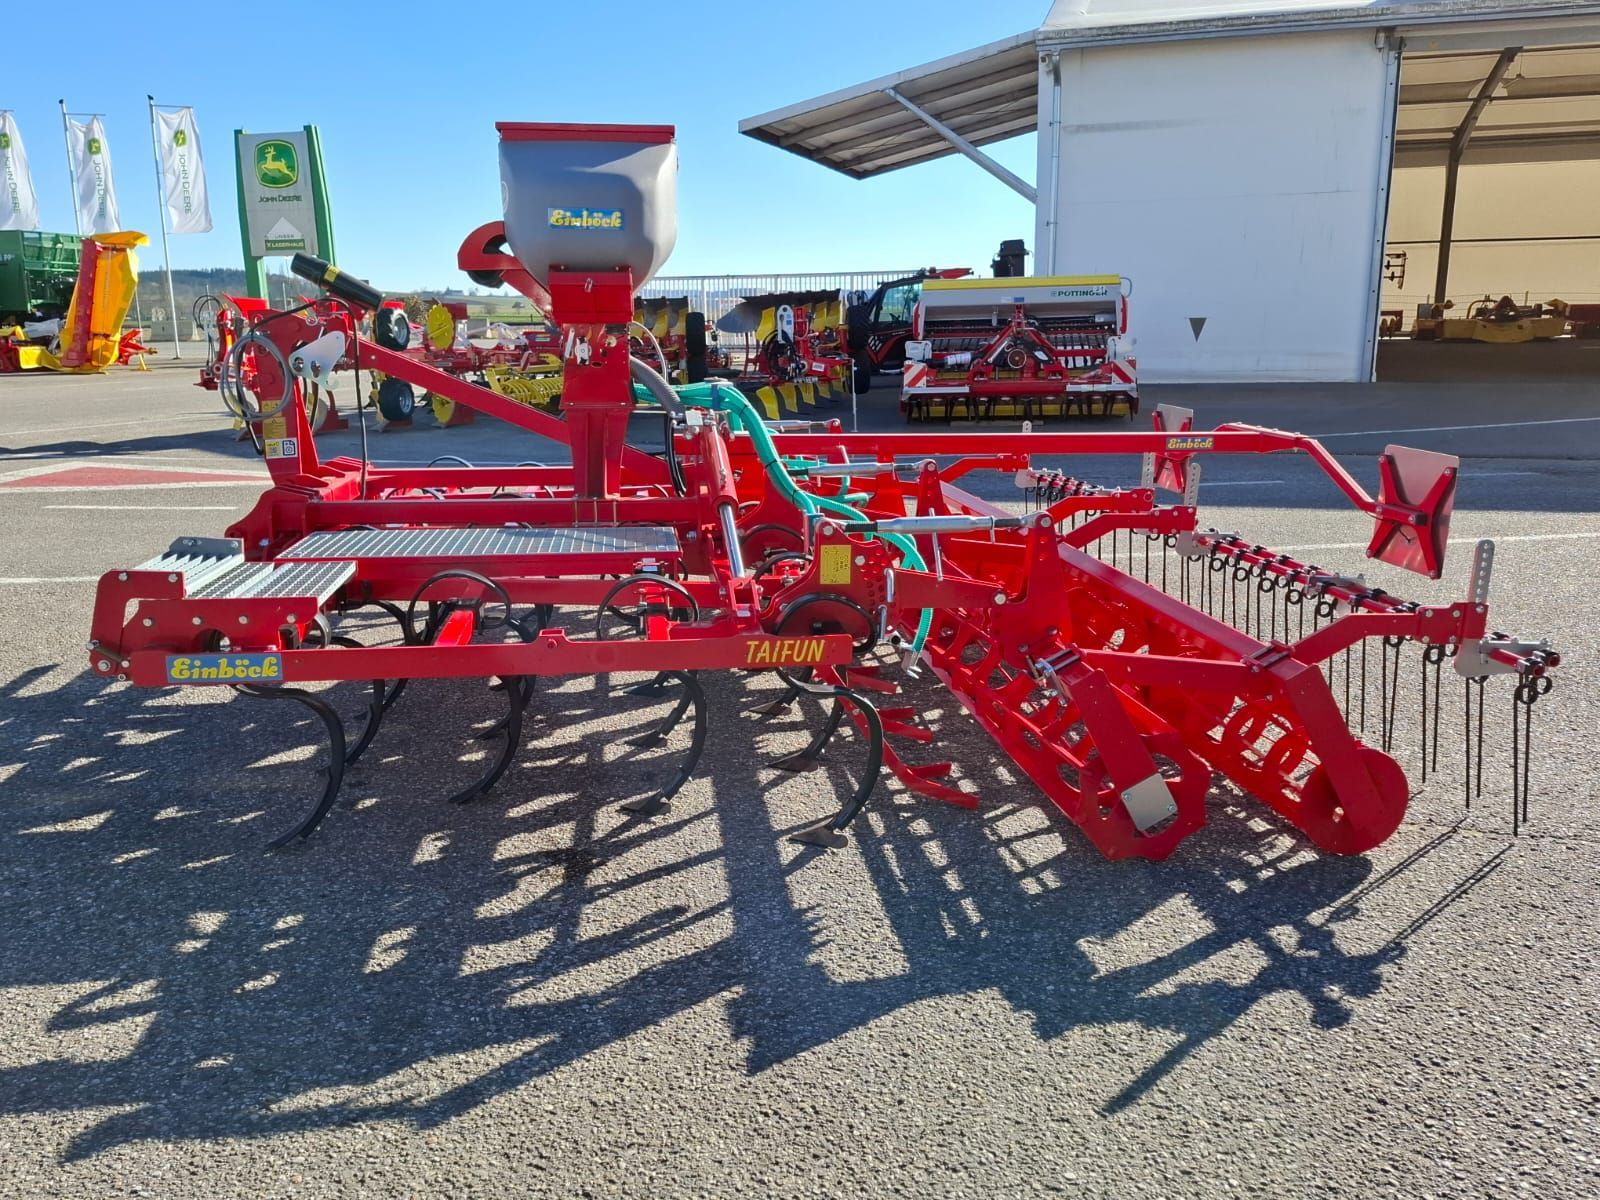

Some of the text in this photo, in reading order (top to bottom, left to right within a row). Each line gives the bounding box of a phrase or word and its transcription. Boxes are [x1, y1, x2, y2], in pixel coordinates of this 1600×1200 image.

[93, 159, 105, 187] JOHN
[178, 154, 192, 215] JOHN DEERE
[258, 195, 277, 203] JOHN
[550, 209, 622, 228] Einböck
[1167, 438, 1214, 449] Einböck
[745, 639, 826, 664] TAIFUN
[170, 656, 279, 679] Einböck
